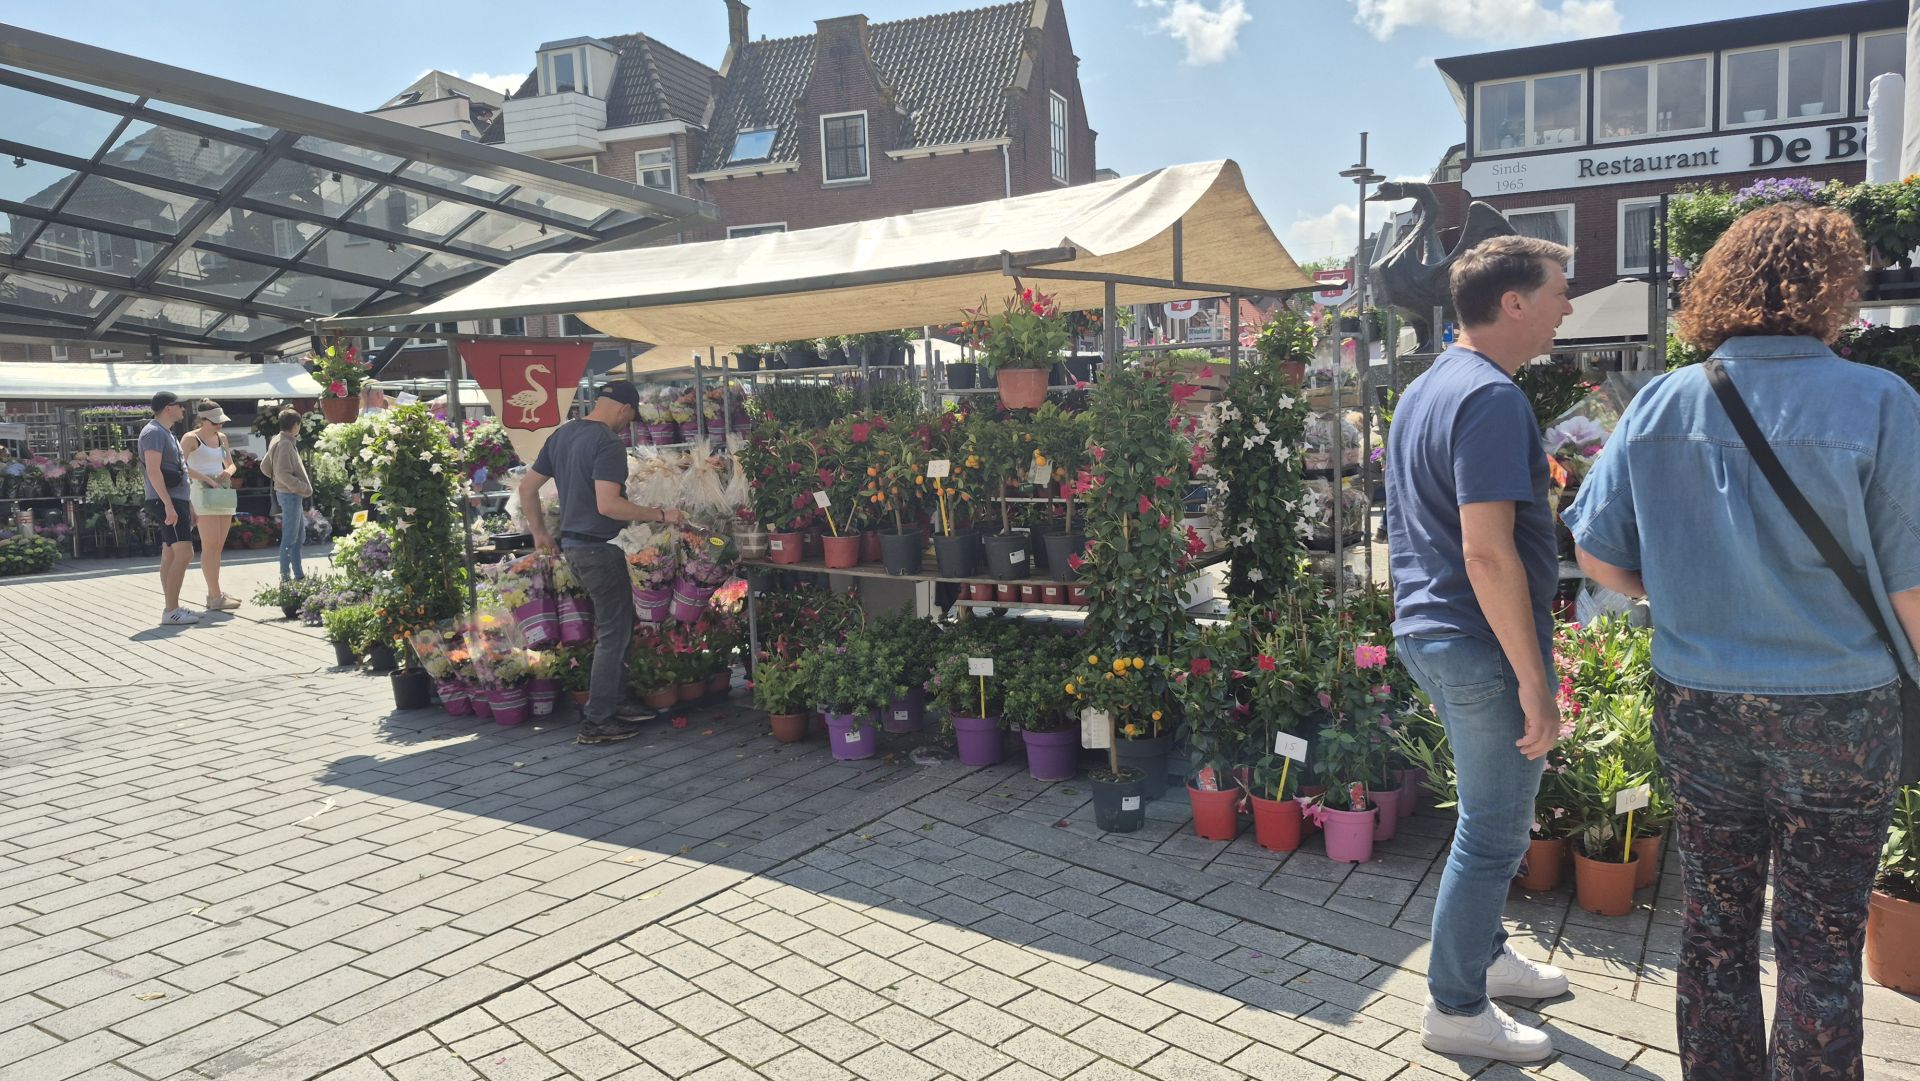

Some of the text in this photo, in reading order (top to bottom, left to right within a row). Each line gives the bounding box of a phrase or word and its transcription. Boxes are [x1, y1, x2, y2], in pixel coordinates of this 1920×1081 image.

[1577, 126, 1868, 178] Restaurant De B
[1492, 161, 1527, 176] Sinds
[1495, 178, 1524, 192] 1965
